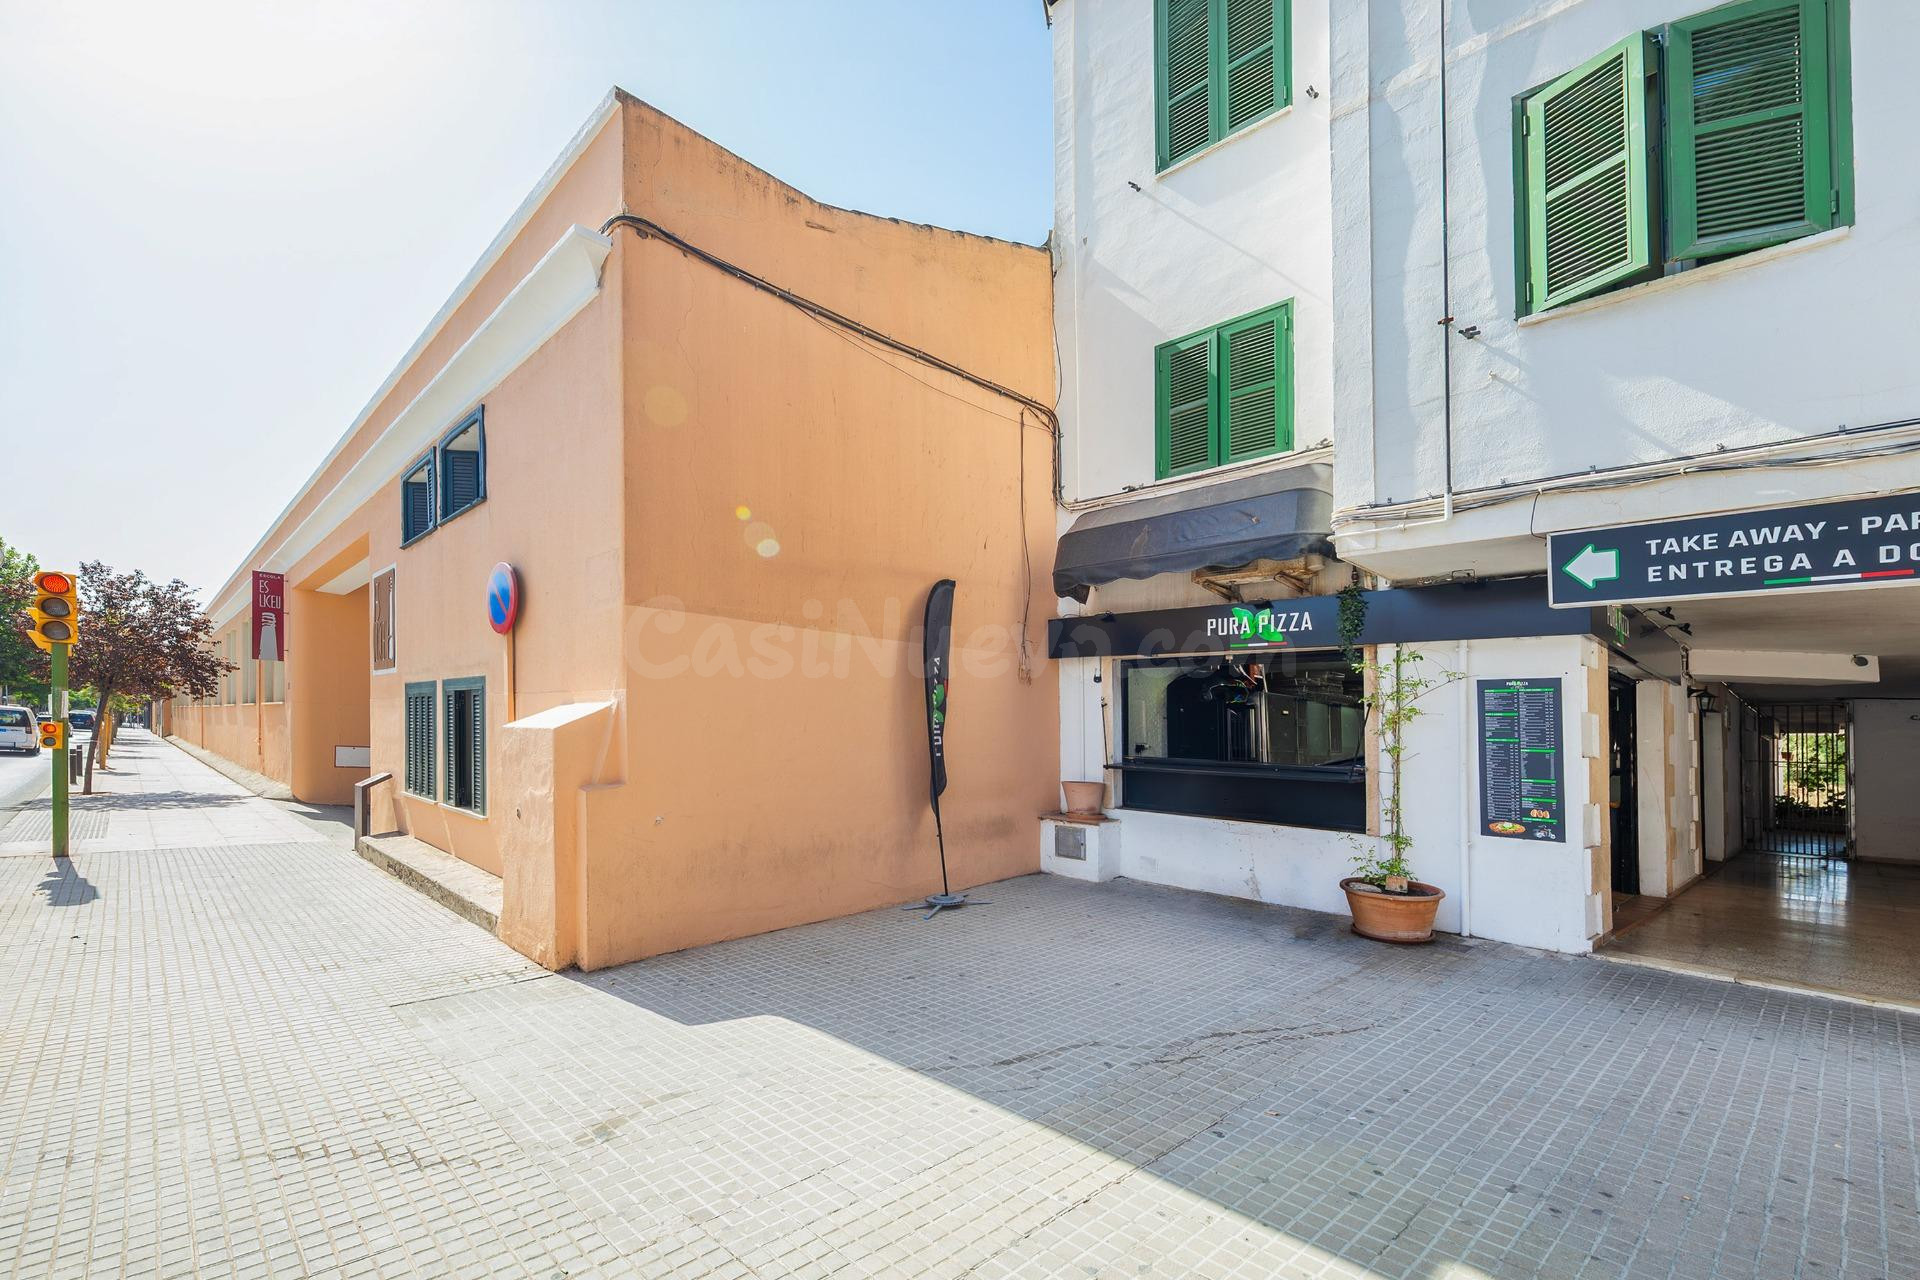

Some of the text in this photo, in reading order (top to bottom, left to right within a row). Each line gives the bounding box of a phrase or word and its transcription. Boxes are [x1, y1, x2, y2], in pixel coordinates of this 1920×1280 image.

[1645, 533, 1719, 556] TAKE
[1727, 521, 1827, 548] AWAY
[1647, 552, 1813, 582] ENTREGA
[1832, 548, 1856, 568] A
[259, 579, 270, 594] ES
[259, 593, 281, 609] LICEU
[1207, 611, 1313, 637] PURA PIZZA
